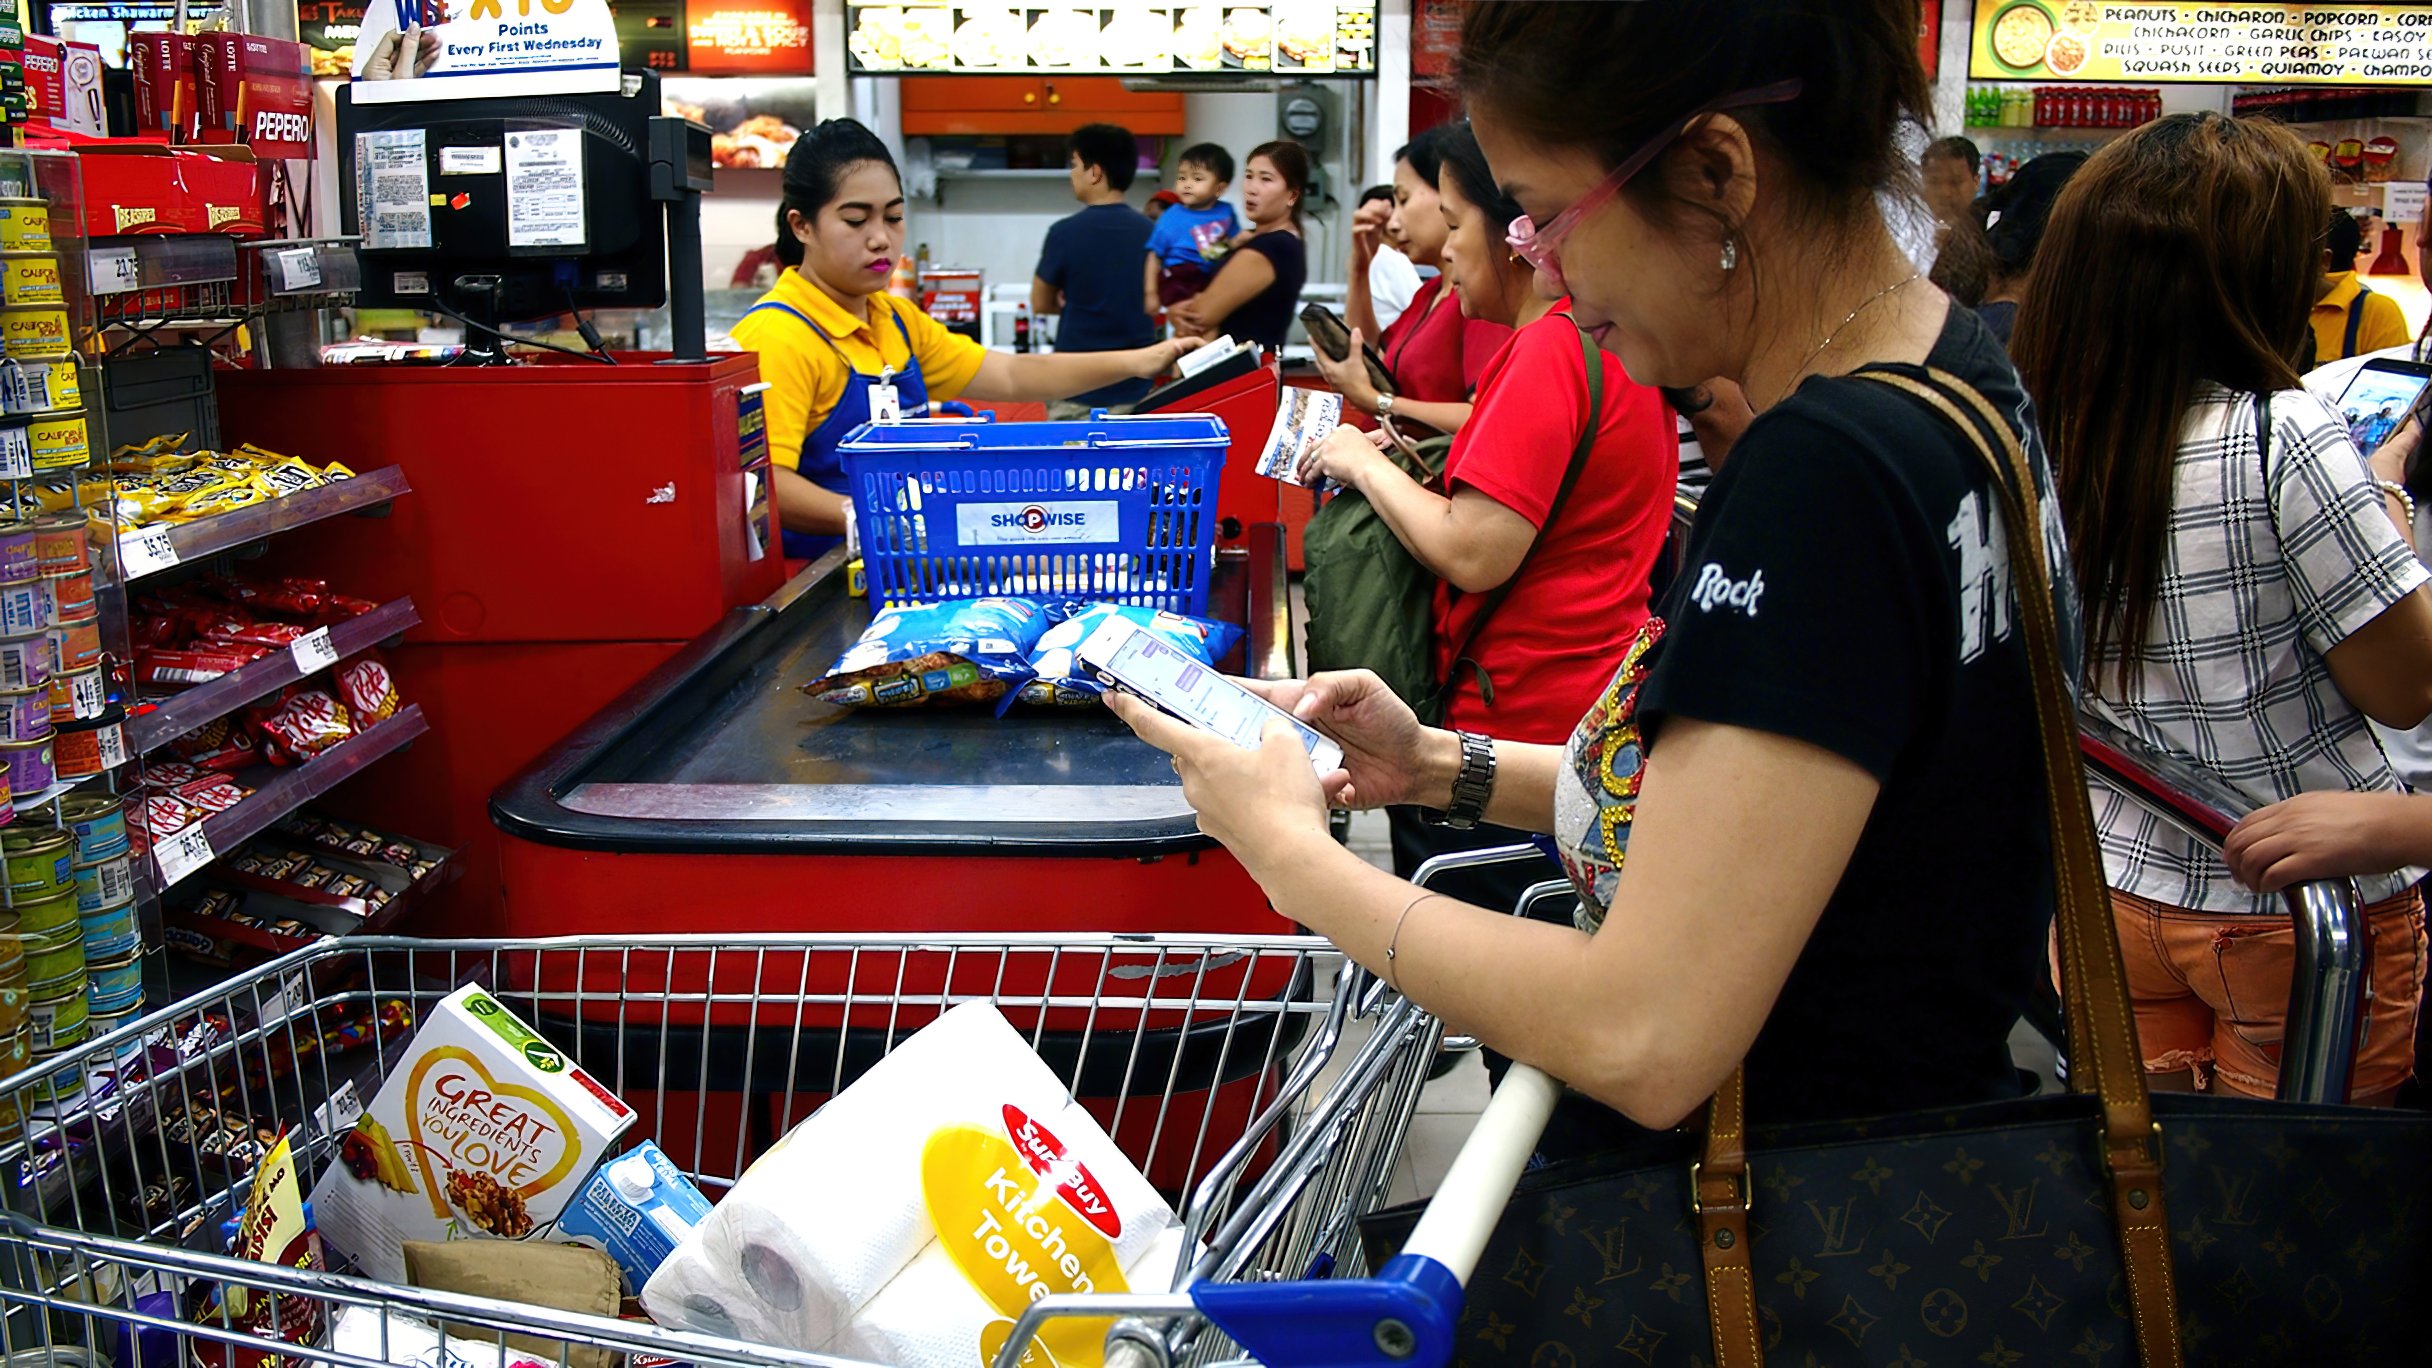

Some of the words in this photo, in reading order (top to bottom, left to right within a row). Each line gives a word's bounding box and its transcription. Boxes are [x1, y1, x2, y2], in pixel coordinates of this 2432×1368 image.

[111, 6, 186, 19] Shawarm
[2105, 8, 2177, 22] PEANUTS
[2304, 12, 2378, 26] POPCORN
[499, 22, 548, 37] Points
[2250, 28, 2303, 42] GARLIC
[2311, 28, 2352, 42] CHIPS
[226, 41, 237, 72] LOTTE
[448, 43, 484, 57] Every
[489, 40, 519, 53] First
[524, 37, 603, 51] Wednesday
[2225, 45, 2273, 57] GREEN
[2280, 46, 2318, 60] PEAS
[2125, 60, 2190, 74] SQUASH
[2199, 61, 2241, 74] SEEDS
[2261, 62, 2344, 76] QUIAMOY
[255, 111, 308, 142] PEPERO
[990, 512, 1086, 528] SHOPWISE
[1691, 562, 1764, 617] Rock
[435, 1074, 555, 1144] GREAT
[427, 1096, 541, 1164] INGREDIENTS
[422, 1112, 460, 1141] YOU
[450, 1129, 538, 1186] LOVE
[1065, 1166, 1108, 1215] Buy
[984, 1166, 1095, 1297] Kitchen
[973, 1209, 1052, 1303] Towe
